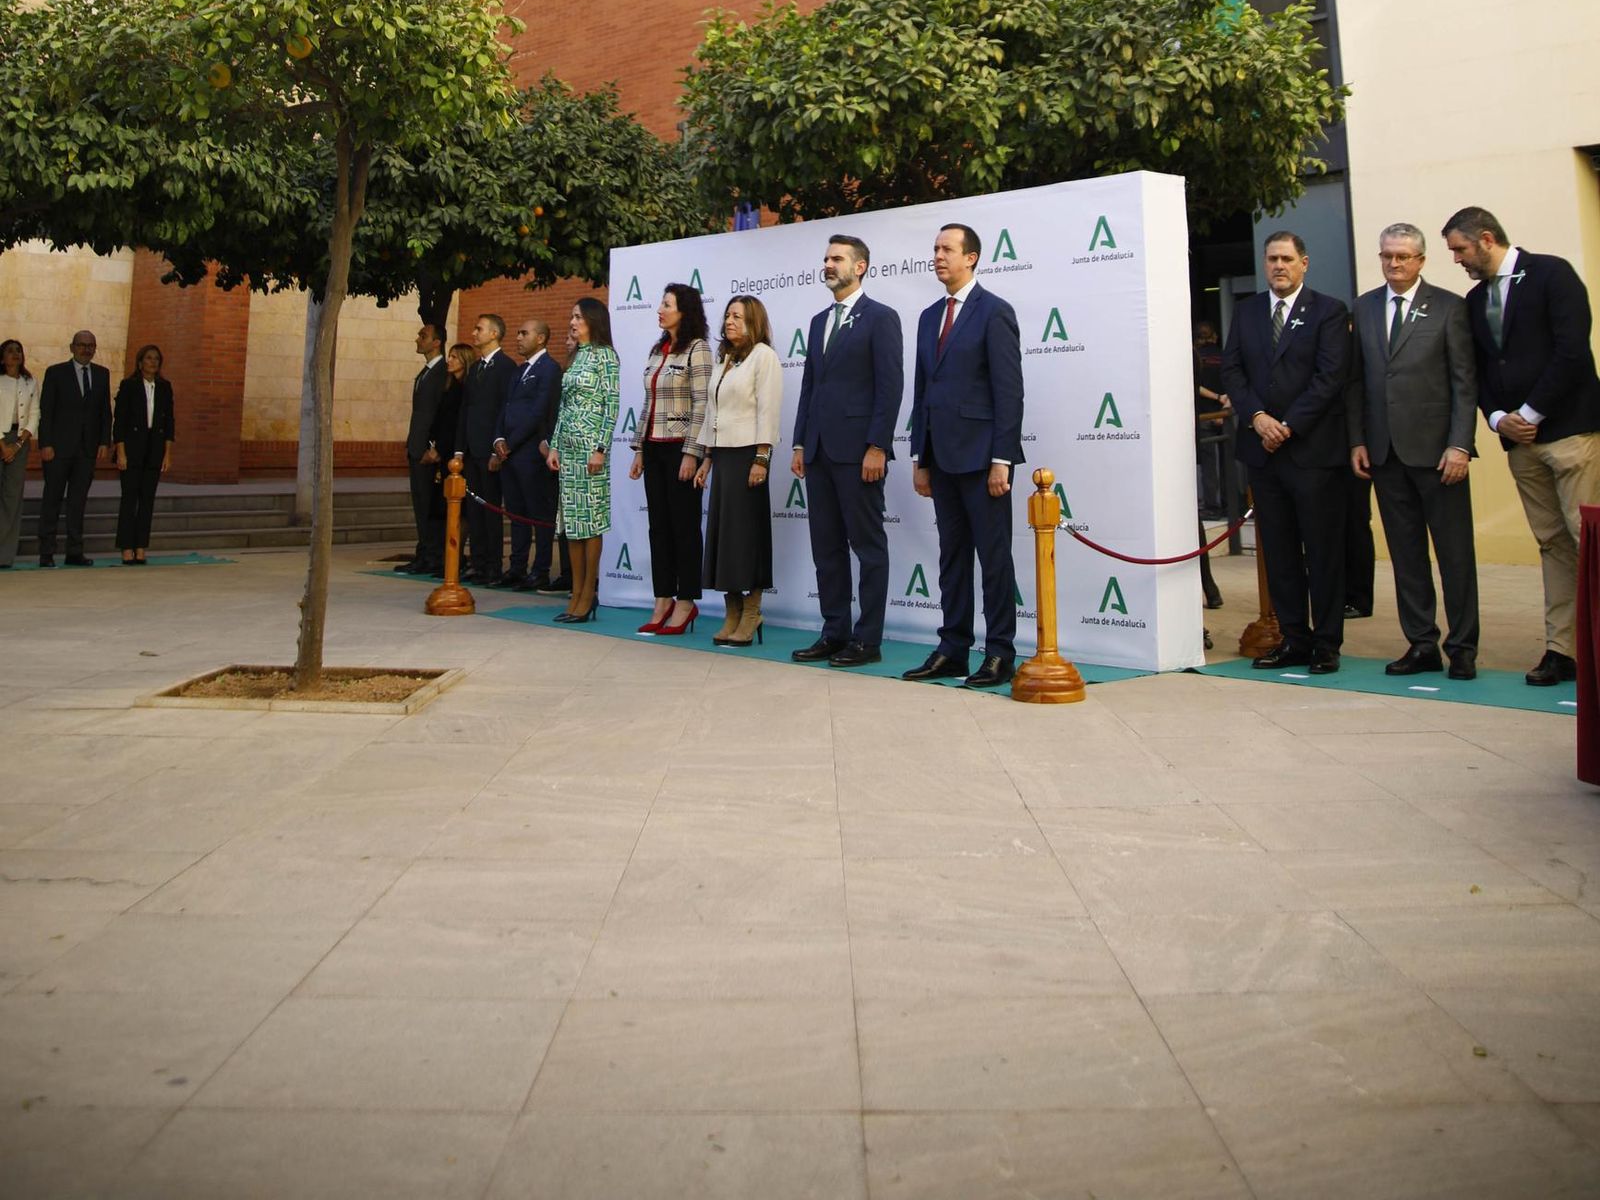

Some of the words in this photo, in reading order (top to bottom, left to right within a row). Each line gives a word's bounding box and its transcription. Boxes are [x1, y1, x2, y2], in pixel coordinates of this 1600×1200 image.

[1091, 255, 1099, 263] de
[1100, 250, 1134, 261] Andalucía
[731, 273, 794, 295] Delegación
[797, 269, 815, 286] del
[881, 265, 897, 277] en
[901, 258, 935, 275] Alme
[976, 267, 993, 275] Junta
[1025, 347, 1043, 355] Junta
[1053, 343, 1085, 353] Andalucía
[1076, 433, 1095, 441] Junta
[1096, 432, 1105, 440] de
[1106, 431, 1140, 440] Andalucía
[1081, 616, 1100, 624] Junta
[1111, 618, 1146, 629] Andalucía
